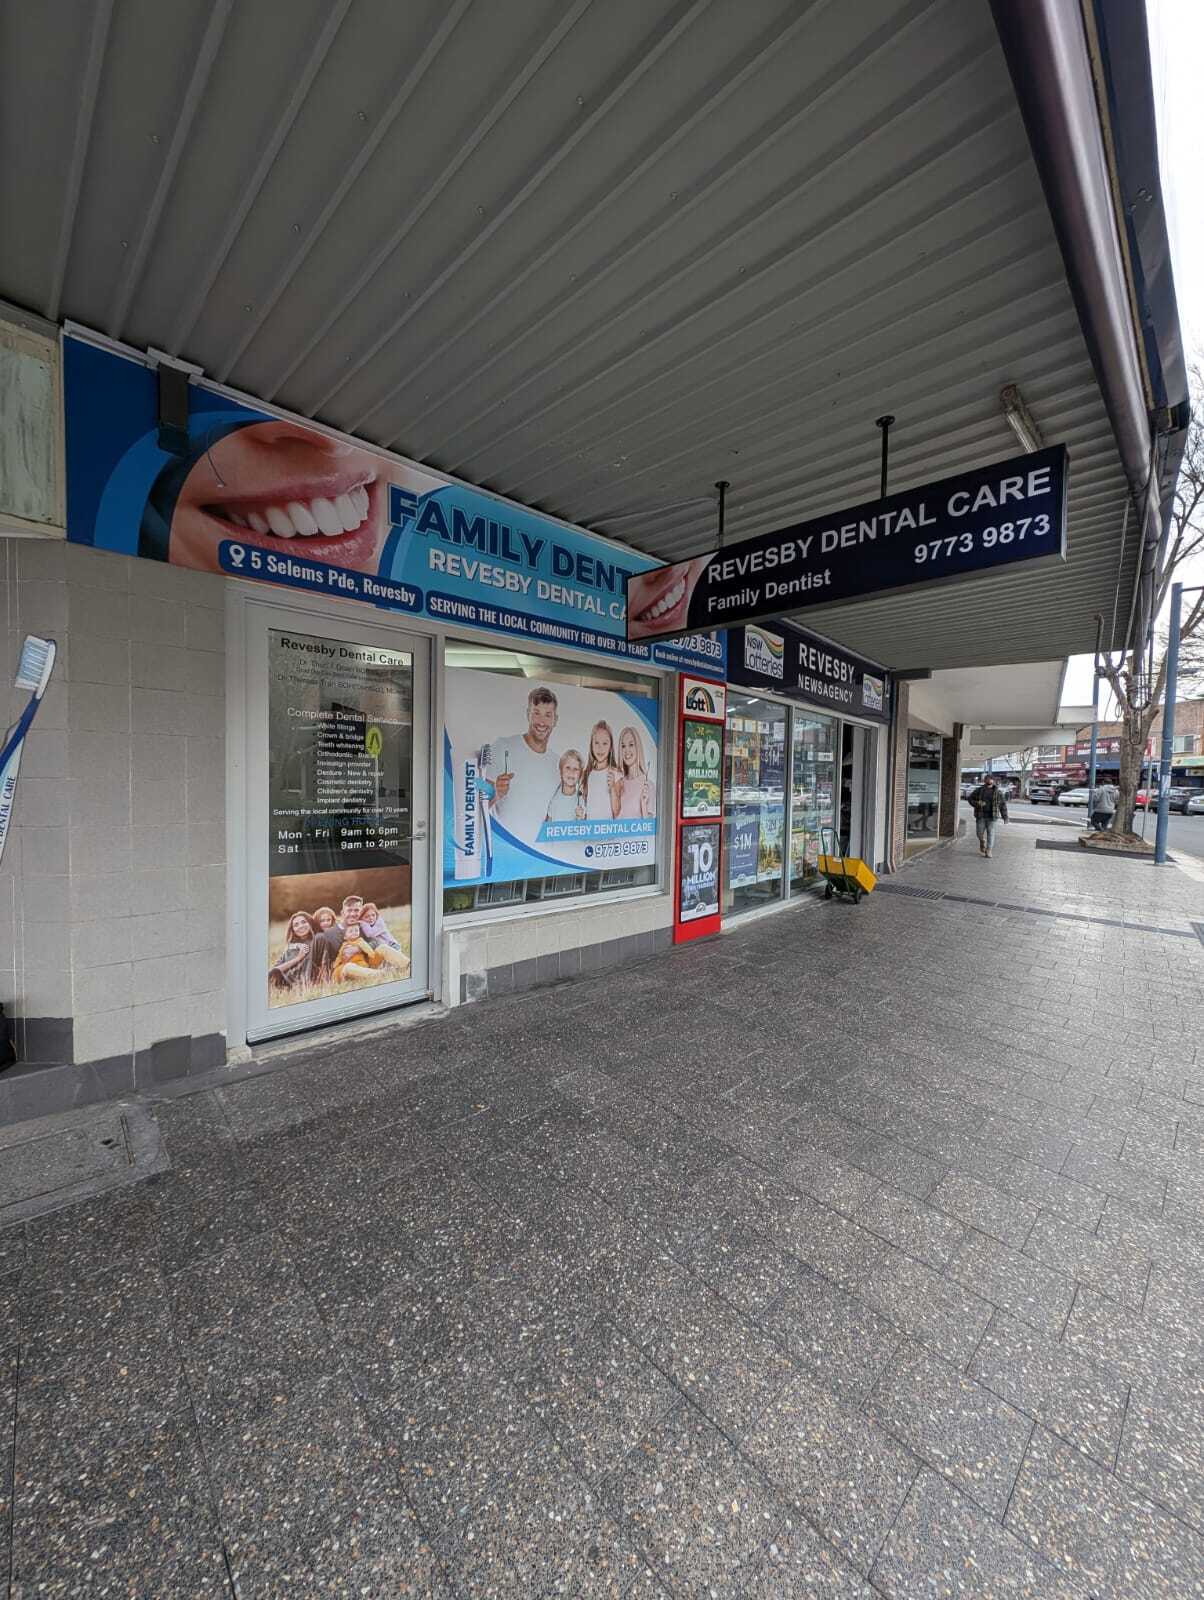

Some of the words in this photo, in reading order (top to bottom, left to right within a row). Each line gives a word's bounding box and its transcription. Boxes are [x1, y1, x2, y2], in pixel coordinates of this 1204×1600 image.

[388, 483, 547, 569] FAMILY
[708, 536, 813, 584] REVESBY
[821, 503, 936, 553] DENTAL
[947, 467, 1051, 517] CARE
[914, 532, 974, 564] 9773
[982, 514, 1050, 548] 9873
[251, 552, 262, 569] 5
[267, 555, 324, 584] Selems
[328, 572, 359, 593] Pde,
[363, 579, 416, 606] Revesby
[429, 549, 532, 595] REVESBY
[537, 580, 606, 616] DENTAL
[708, 588, 760, 613] Family
[766, 568, 831, 599] Dentist
[430, 597, 476, 619] SERVING
[478, 608, 497, 624] THE
[499, 612, 528, 631] LOCAL
[530, 620, 579, 642] COMMUNITY
[581, 632, 595, 646] FOR
[597, 637, 616, 650] OVER
[617, 641, 626, 652] 70
[628, 643, 649, 657] YEARS
[281, 638, 336, 657] Revesby
[340, 647, 375, 662] Dental
[379, 654, 404, 666] Care
[699, 637, 722, 658] 9873
[746, 635, 763, 650] NSW
[745, 649, 783, 677] Lotteries
[799, 642, 855, 684] REVESBY
[798, 673, 854, 704] NEWSAGENCY
[287, 707, 334, 720] Complete
[336, 712, 365, 722] Dental
[686, 695, 706, 711] Lott
[3, 775, 16, 800] CARE
[465, 761, 476, 813] DENTIST
[688, 768, 719, 779] MILLION
[278, 830, 303, 840] Mon
[315, 828, 330, 838] Fri
[341, 828, 362, 837] 9am
[366, 827, 375, 835] to
[378, 826, 398, 837] 6pm
[465, 814, 475, 856] FAMILY
[546, 825, 593, 837] REVESBY
[594, 823, 629, 835] DENTAL
[631, 822, 653, 832] CARE
[734, 833, 752, 850] $1M
[278, 844, 299, 854] Sat
[341, 841, 362, 850] 9am
[366, 840, 375, 848] to
[378, 839, 398, 849] 2pm
[594, 843, 621, 858] 9773
[622, 840, 649, 856] 9873
